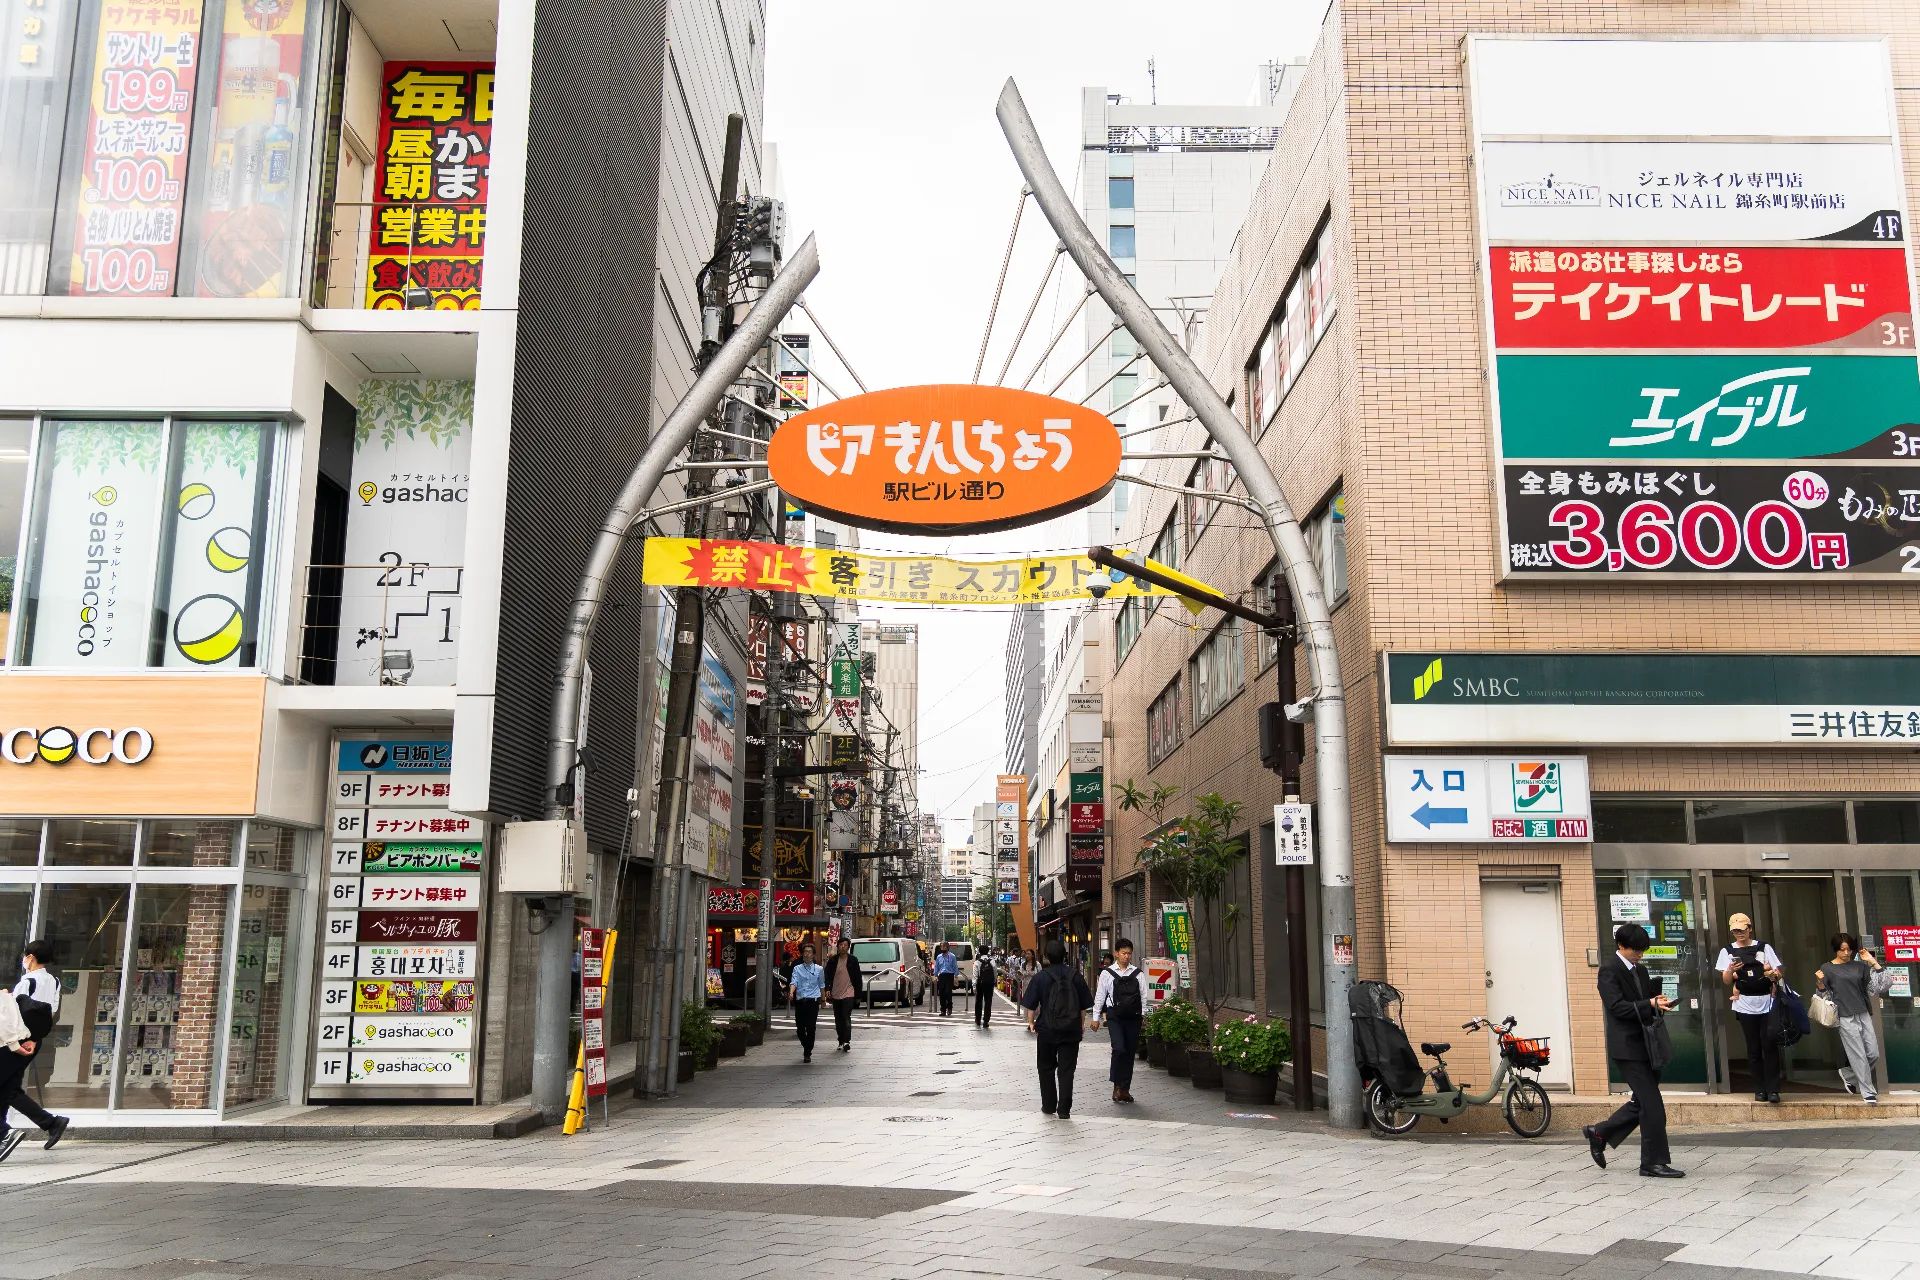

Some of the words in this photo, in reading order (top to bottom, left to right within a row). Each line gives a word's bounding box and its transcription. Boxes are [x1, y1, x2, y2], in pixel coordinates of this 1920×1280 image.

[108, 34, 192, 65] サントリー生
[104, 69, 188, 112] 199円
[99, 120, 184, 136] レモンサワー
[96, 159, 179, 201] 100円
[384, 164, 491, 199] 朝ま
[1638, 171, 1803, 188] ジェルネイル専門店
[1508, 188, 1548, 200] NICE
[1609, 193, 1663, 209] NICE
[1672, 193, 1727, 209] NAIL
[1736, 193, 1846, 210] 錦糸町駅前店
[381, 207, 486, 245] 営業中
[1872, 215, 1900, 239] 4F
[85, 249, 169, 292] 100円
[1508, 251, 1743, 274] 派遣のお仕事探しなら
[376, 261, 484, 288] 食べ飲み
[1512, 281, 1867, 323] テイケイトレード
[1880, 321, 1910, 345] 3F
[1609, 366, 1812, 447] エイブル
[805, 422, 876, 476] ピア
[884, 418, 1073, 476] きんしちょう
[1891, 430, 1920, 456] 3F
[883, 481, 1005, 502] 駅ビル通り
[1518, 470, 1717, 496] 全身もみほぐし
[1788, 477, 1827, 501] 60分
[1510, 543, 1553, 567] 税込
[1549, 499, 1850, 571] 3,600円
[376, 551, 430, 588] 2F
[711, 546, 793, 586] 禁止
[829, 554, 934, 591] 客引き
[956, 559, 1093, 593] スカウト
[77, 511, 108, 657] gashacoco
[102, 519, 125, 648] カプセルトイショップ
[1453, 677, 1520, 698] SMBC
[1605, 690, 1643, 698] BANKING
[1645, 690, 1705, 698] CORPORATION
[0, 726, 155, 765] coco
[392, 744, 451, 761] 日拓ビ
[838, 738, 853, 749] 2F
[340, 783, 363, 798] 9F
[1074, 782, 1100, 793] エイブル
[1410, 768, 1465, 793] 入口
[337, 816, 360, 831] 8F
[376, 818, 470, 833] テナント募集中
[1494, 821, 1524, 836] たばこ
[1531, 821, 1549, 837] 酒
[1559, 820, 1586, 836] ATM
[336, 850, 358, 865] 7F
[387, 853, 459, 868] ビアポンバー
[333, 884, 356, 899] 6F
[372, 888, 467, 902] テナント募集中
[331, 919, 353, 934] 5F
[328, 954, 350, 969] 4F
[370, 956, 445, 976] 홍대포차
[326, 989, 348, 1004] 3F
[323, 1025, 345, 1040] 2F
[378, 1025, 454, 1038] gashacoco
[323, 1060, 342, 1075] 1F
[376, 1060, 452, 1073] gashacoco
